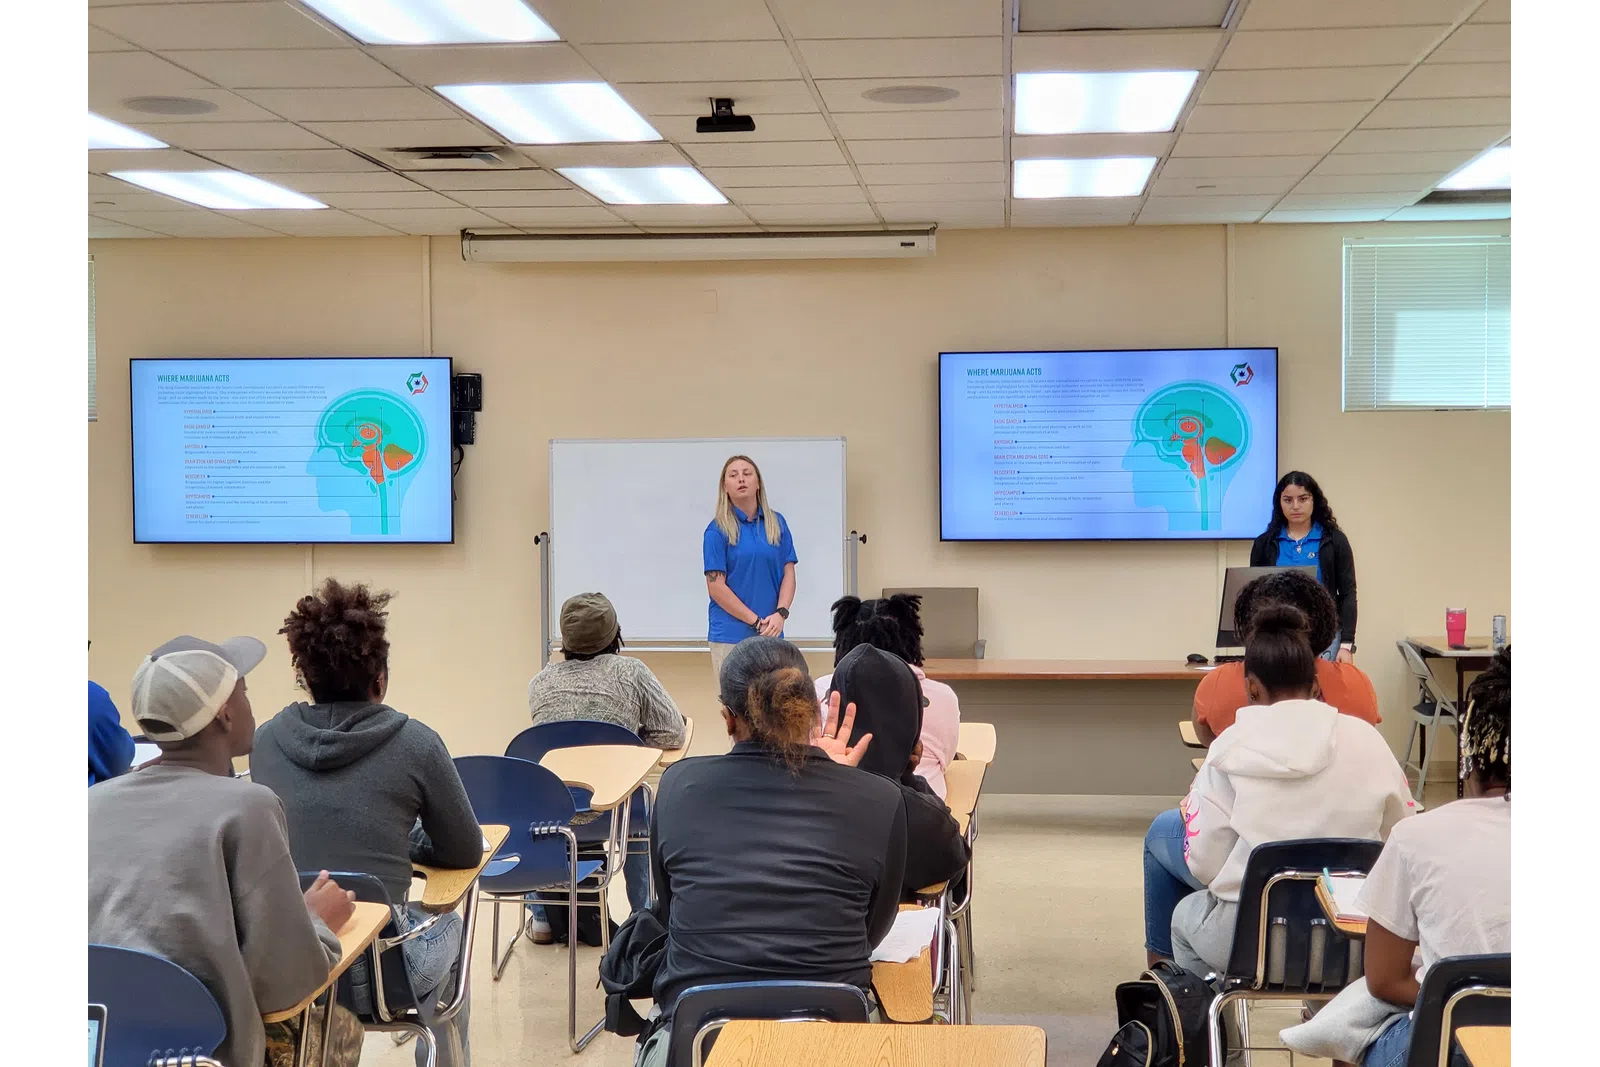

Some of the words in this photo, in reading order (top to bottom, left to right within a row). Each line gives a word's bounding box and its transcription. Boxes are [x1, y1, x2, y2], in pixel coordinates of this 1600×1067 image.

[966, 368, 989, 376] WHERE
[157, 374, 179, 382] WHERE
[179, 374, 214, 382] MARIJUANA
[214, 374, 230, 382] ACTS
